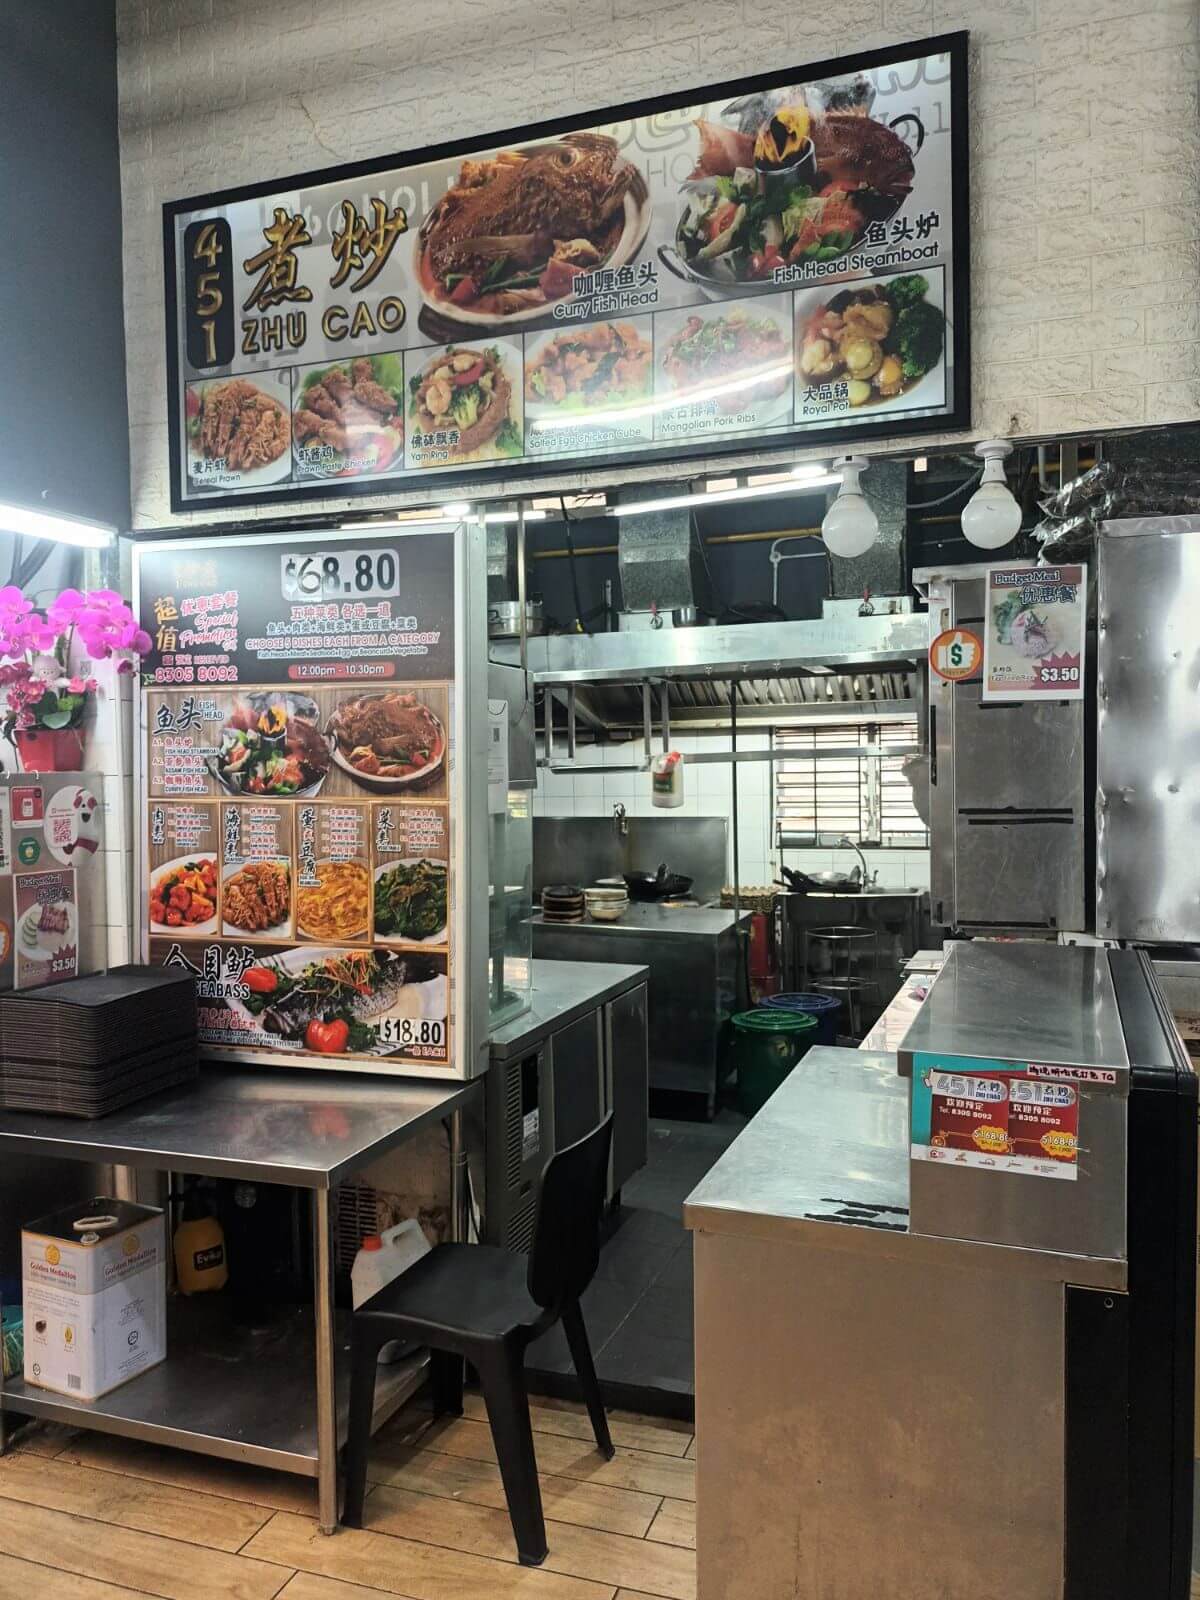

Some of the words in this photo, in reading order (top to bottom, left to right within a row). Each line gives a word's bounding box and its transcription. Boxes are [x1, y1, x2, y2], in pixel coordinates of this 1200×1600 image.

[866, 211, 940, 248] 鱼头炉
[243, 197, 408, 312] 煮炒
[774, 265, 802, 283] Fish
[805, 259, 848, 278] Head
[851, 242, 939, 270] Steamboat
[193, 223, 223, 365] 451
[553, 301, 592, 318] Curry
[592, 296, 617, 313] Fish
[620, 288, 659, 308] Head
[241, 311, 306, 354] ZHU
[322, 296, 406, 341] CAO
[802, 382, 849, 402] 大品锅
[802, 403, 831, 416] Royal
[832, 401, 850, 411] Pot
[661, 417, 712, 433] Mongolian
[713, 416, 734, 427] Pork
[736, 412, 756, 423] Ribs
[529, 437, 556, 449] Salted
[558, 436, 576, 449] Egg
[577, 431, 616, 444] Chicken
[617, 428, 642, 440] Cube
[411, 452, 431, 462] Yam
[431, 450, 448, 461] Ring
[285, 552, 397, 595] $68.80
[995, 573, 1034, 585] Budget
[1033, 570, 1060, 582] Meal
[154, 596, 178, 652] 超值
[246, 638, 285, 650] CHOOSE
[292, 636, 323, 648] DISHES
[324, 635, 351, 647] EACH
[351, 635, 378, 646] FROM
[379, 634, 387, 645] A
[388, 631, 440, 645] CATEGORY
[155, 666, 195, 682] 8305
[197, 665, 238, 681] 8092
[1041, 668, 1079, 683] $3.50
[153, 697, 203, 735] 鱼头
[200, 701, 215, 710] FISH
[52, 957, 75, 972] $3.50
[384, 1017, 441, 1045] $18.80
[30, 1261, 49, 1273] Golden
[49, 1266, 77, 1281] Medallion
